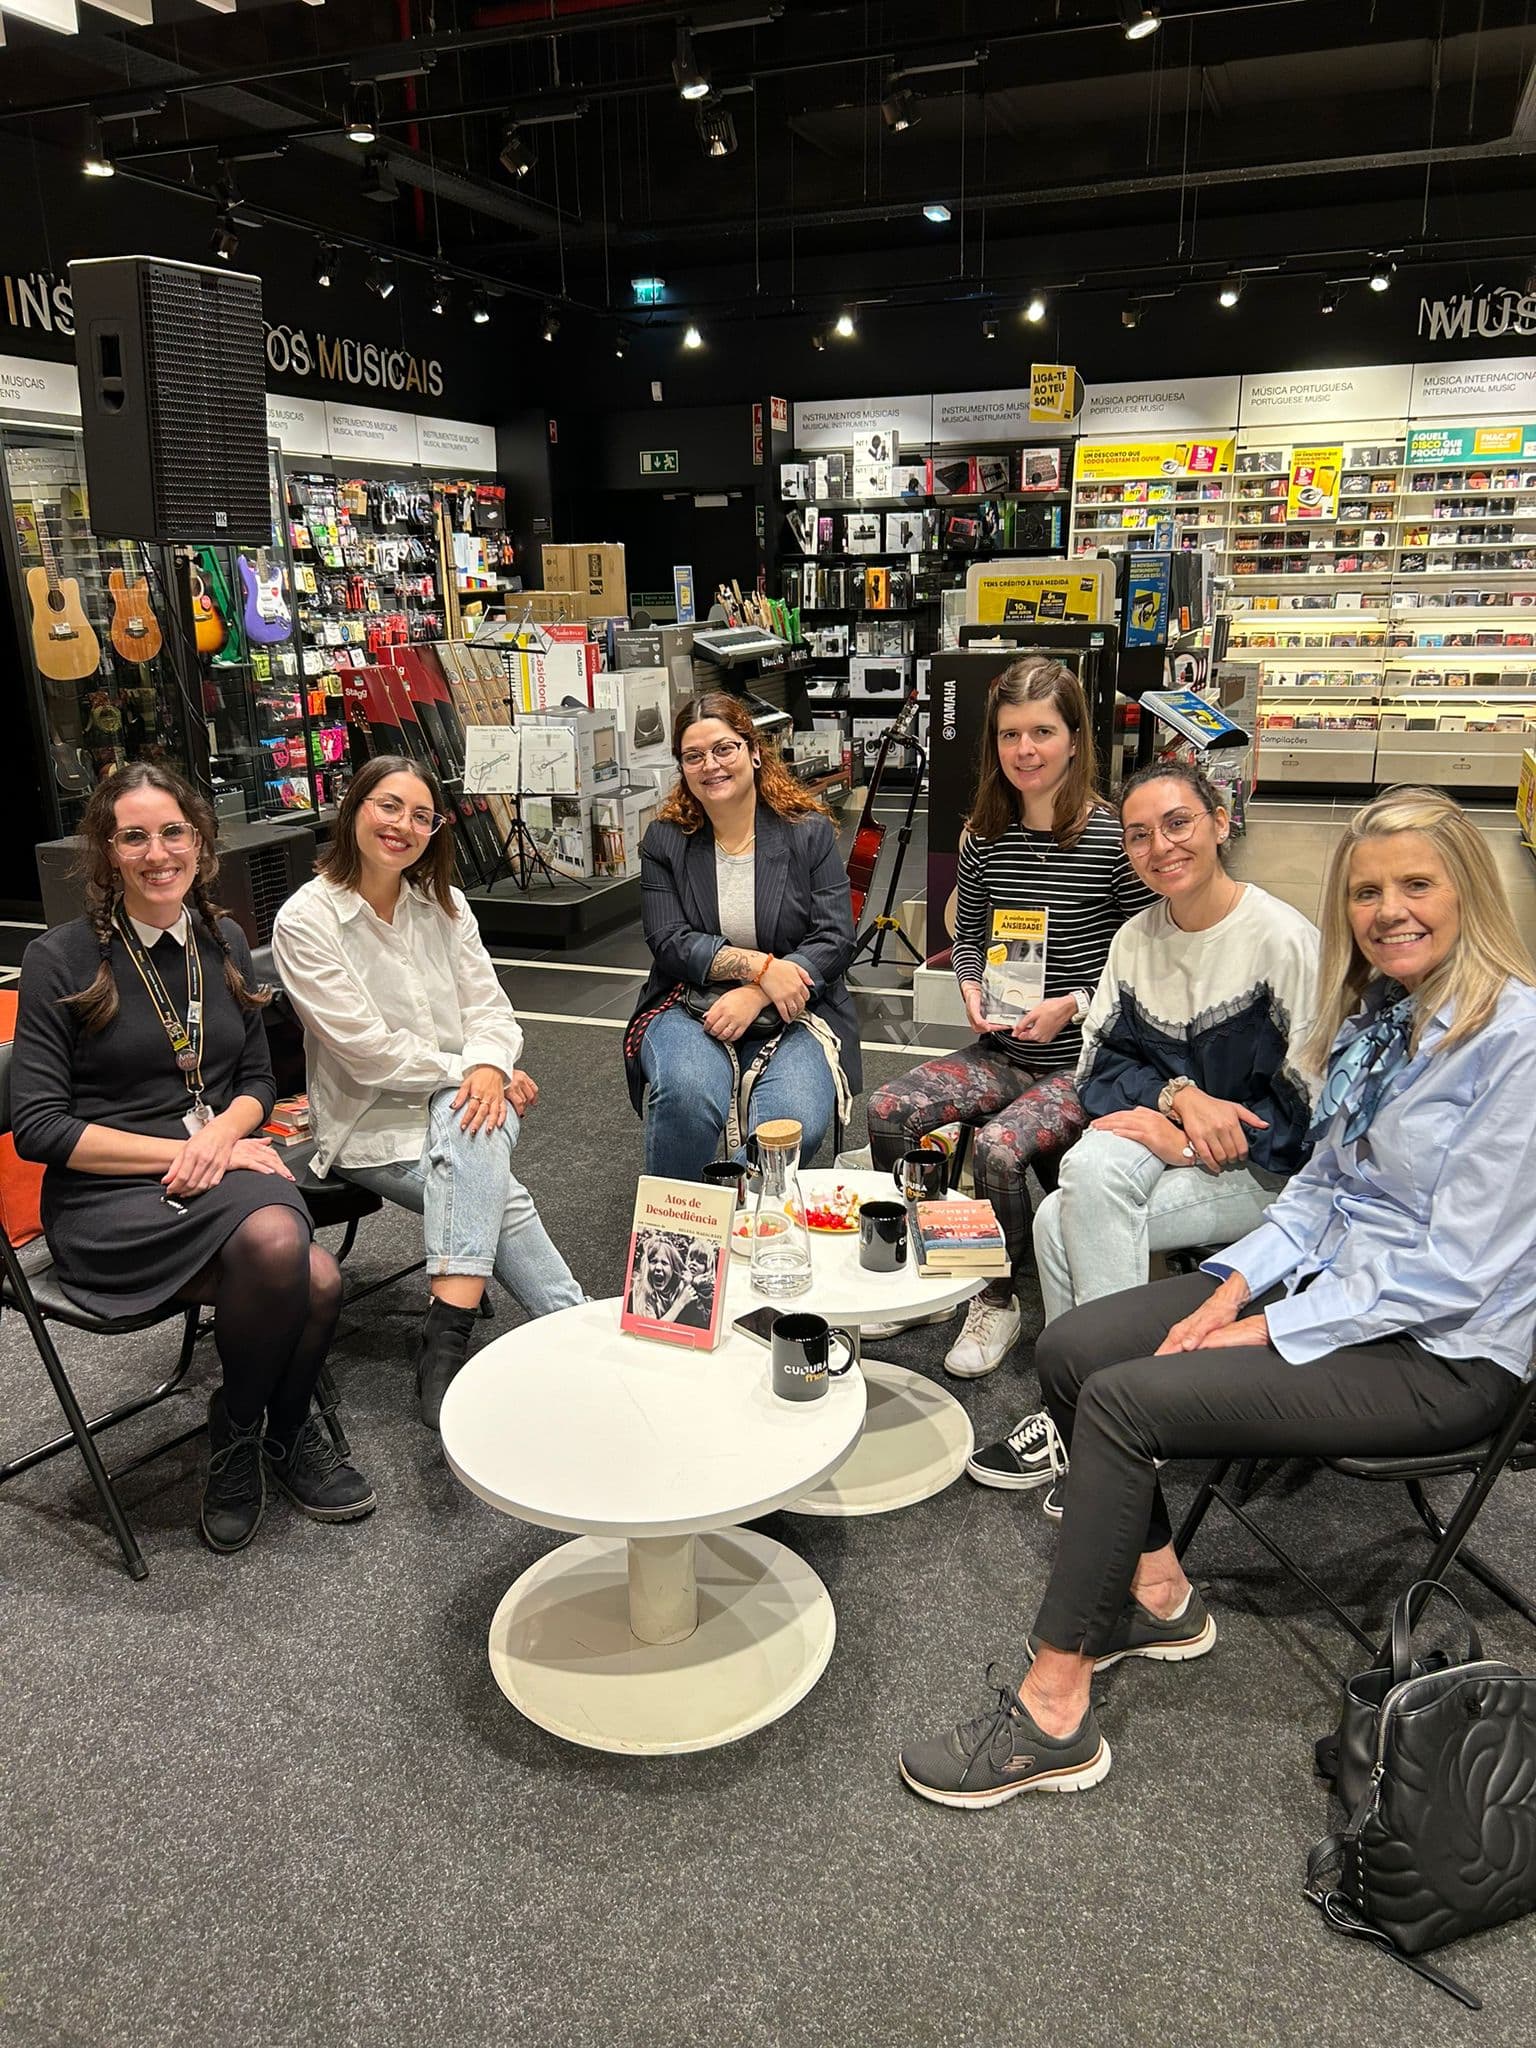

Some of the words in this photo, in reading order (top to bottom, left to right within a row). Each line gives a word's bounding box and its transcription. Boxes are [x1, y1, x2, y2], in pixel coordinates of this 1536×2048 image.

[318, 337, 443, 396] MUSICAIS
[1, 374, 46, 390] MUSICAIS
[1033, 371, 1067, 384] LIGA-TE
[1424, 374, 1462, 386] MÚSICA
[1034, 385, 1048, 396] AO
[1048, 383, 1065, 394] TEU
[1252, 385, 1288, 397] MÚSICA
[1290, 382, 1354, 394] PORTUGUESA
[1423, 385, 1486, 396] INTERNATIONAL
[1488, 383, 1517, 393] MUSIC
[1034, 397, 1055, 407] SOM
[1091, 394, 1125, 406] MÚSICA
[1125, 392, 1185, 404] PORTUGUESA
[1251, 396, 1303, 406] PORTUGUESE
[1305, 394, 1331, 403] MUSIC
[275, 409, 305, 422] MUSICAIS
[802, 411, 862, 422] INSTRUMENTOS
[862, 409, 900, 419] MUSICAIS
[942, 403, 1005, 415] INSTRUMENTOS
[1090, 405, 1139, 415] PORTUGUESE
[1140, 404, 1165, 413] MUSIC
[333, 416, 374, 430] INSTRUMENTOS
[374, 422, 398, 433] MUSICAIS
[942, 415, 972, 424] MUSICAL
[972, 412, 1021, 422] INSTRUMENTS
[802, 421, 830, 430] MUSICAL
[831, 420, 878, 429] INSTRUMENTS
[423, 430, 459, 443] INSTRUMENTOS
[1413, 432, 1448, 441] AQUELE
[1412, 440, 1441, 449] DISCO
[1443, 439, 1463, 448] QUE
[1411, 447, 1462, 457] PROCURAS
[1032, 579, 1044, 587] TUA
[345, 687, 367, 700] Stagg
[944, 680, 956, 726] YAMAHA
[1260, 734, 1308, 745] Compilações
[1001, 921, 1043, 931] ANSIEDADE!
[665, 1194, 687, 1207] Atos
[689, 1198, 702, 1208] de
[645, 1204, 718, 1226] Desobediência
